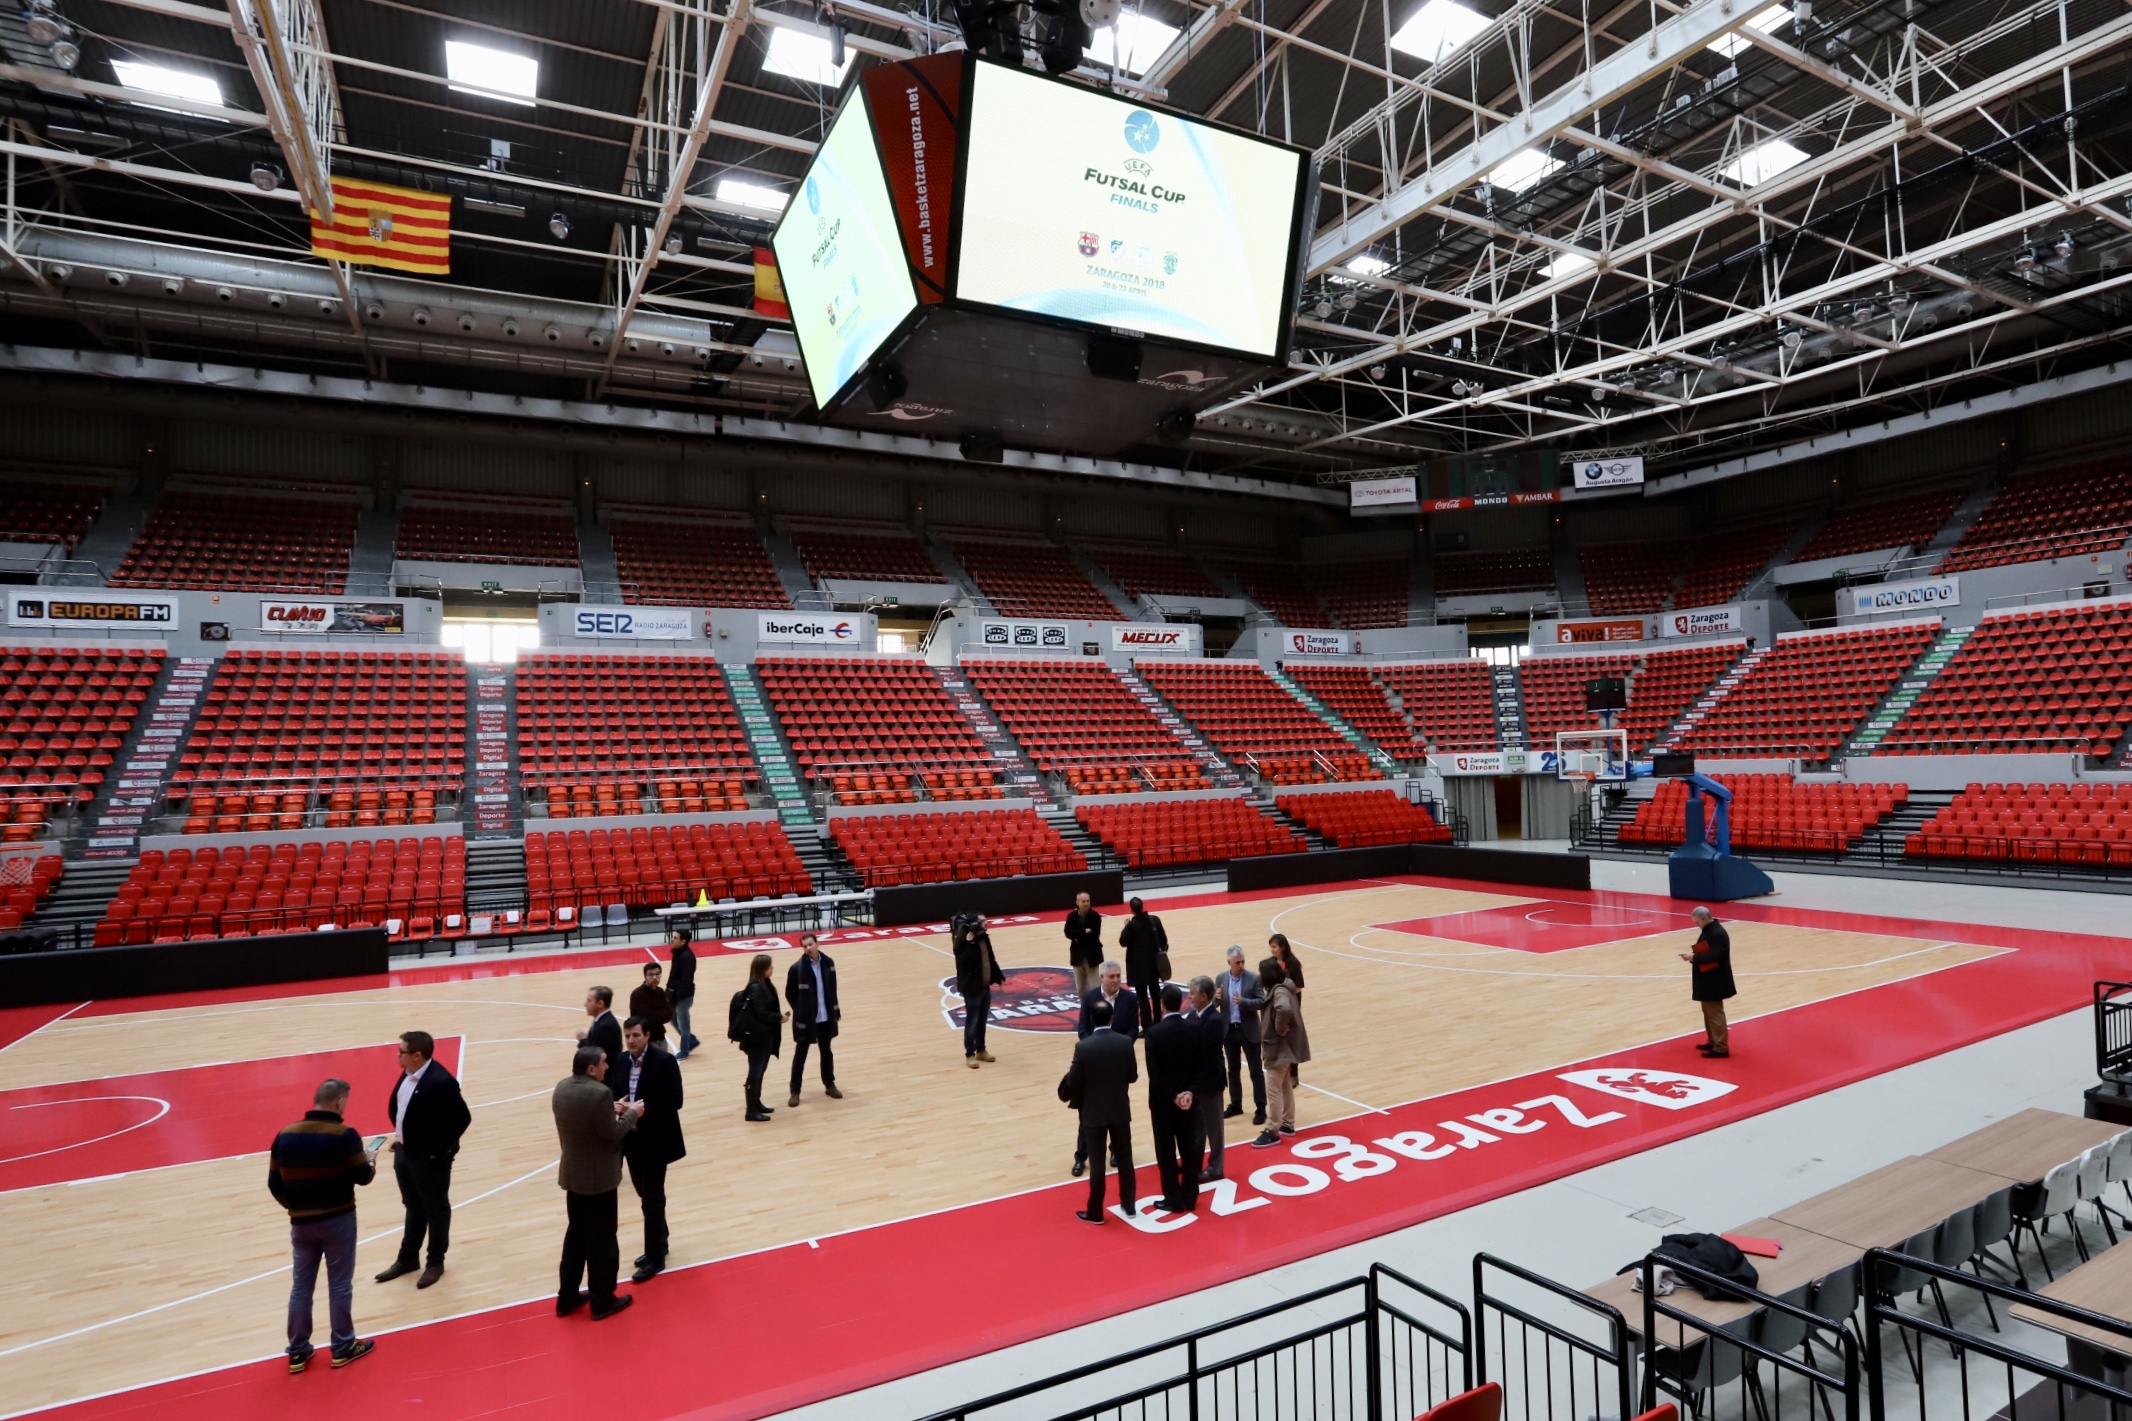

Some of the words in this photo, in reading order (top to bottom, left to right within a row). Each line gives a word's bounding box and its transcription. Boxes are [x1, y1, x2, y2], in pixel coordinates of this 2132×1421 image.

[906, 86, 934, 268] www.basketzaragoza.net
[1124, 160, 1151, 177] UEFA
[1084, 168, 1147, 195] FUTSAL
[1151, 185, 1186, 203] CUP
[1110, 193, 1159, 213] FINALS
[1086, 265, 1140, 284] ZARAGOZA
[1474, 496, 1508, 506] MONDO
[1524, 492, 1554, 502] AMBAR
[1876, 585, 1952, 608] MONDO
[577, 612, 633, 634] SER
[656, 622, 688, 630] ZARAGOZA
[1691, 612, 1728, 624] Zaragoza
[766, 622, 824, 637] iberCaja
[1691, 623, 1729, 634] DEPORTE
[1307, 634, 1338, 646] Zaragoza
[1308, 645, 1338, 653] DEPORTE
[815, 914, 1041, 943] Zaragza
[1107, 1094, 1627, 1234] Zaragoza
